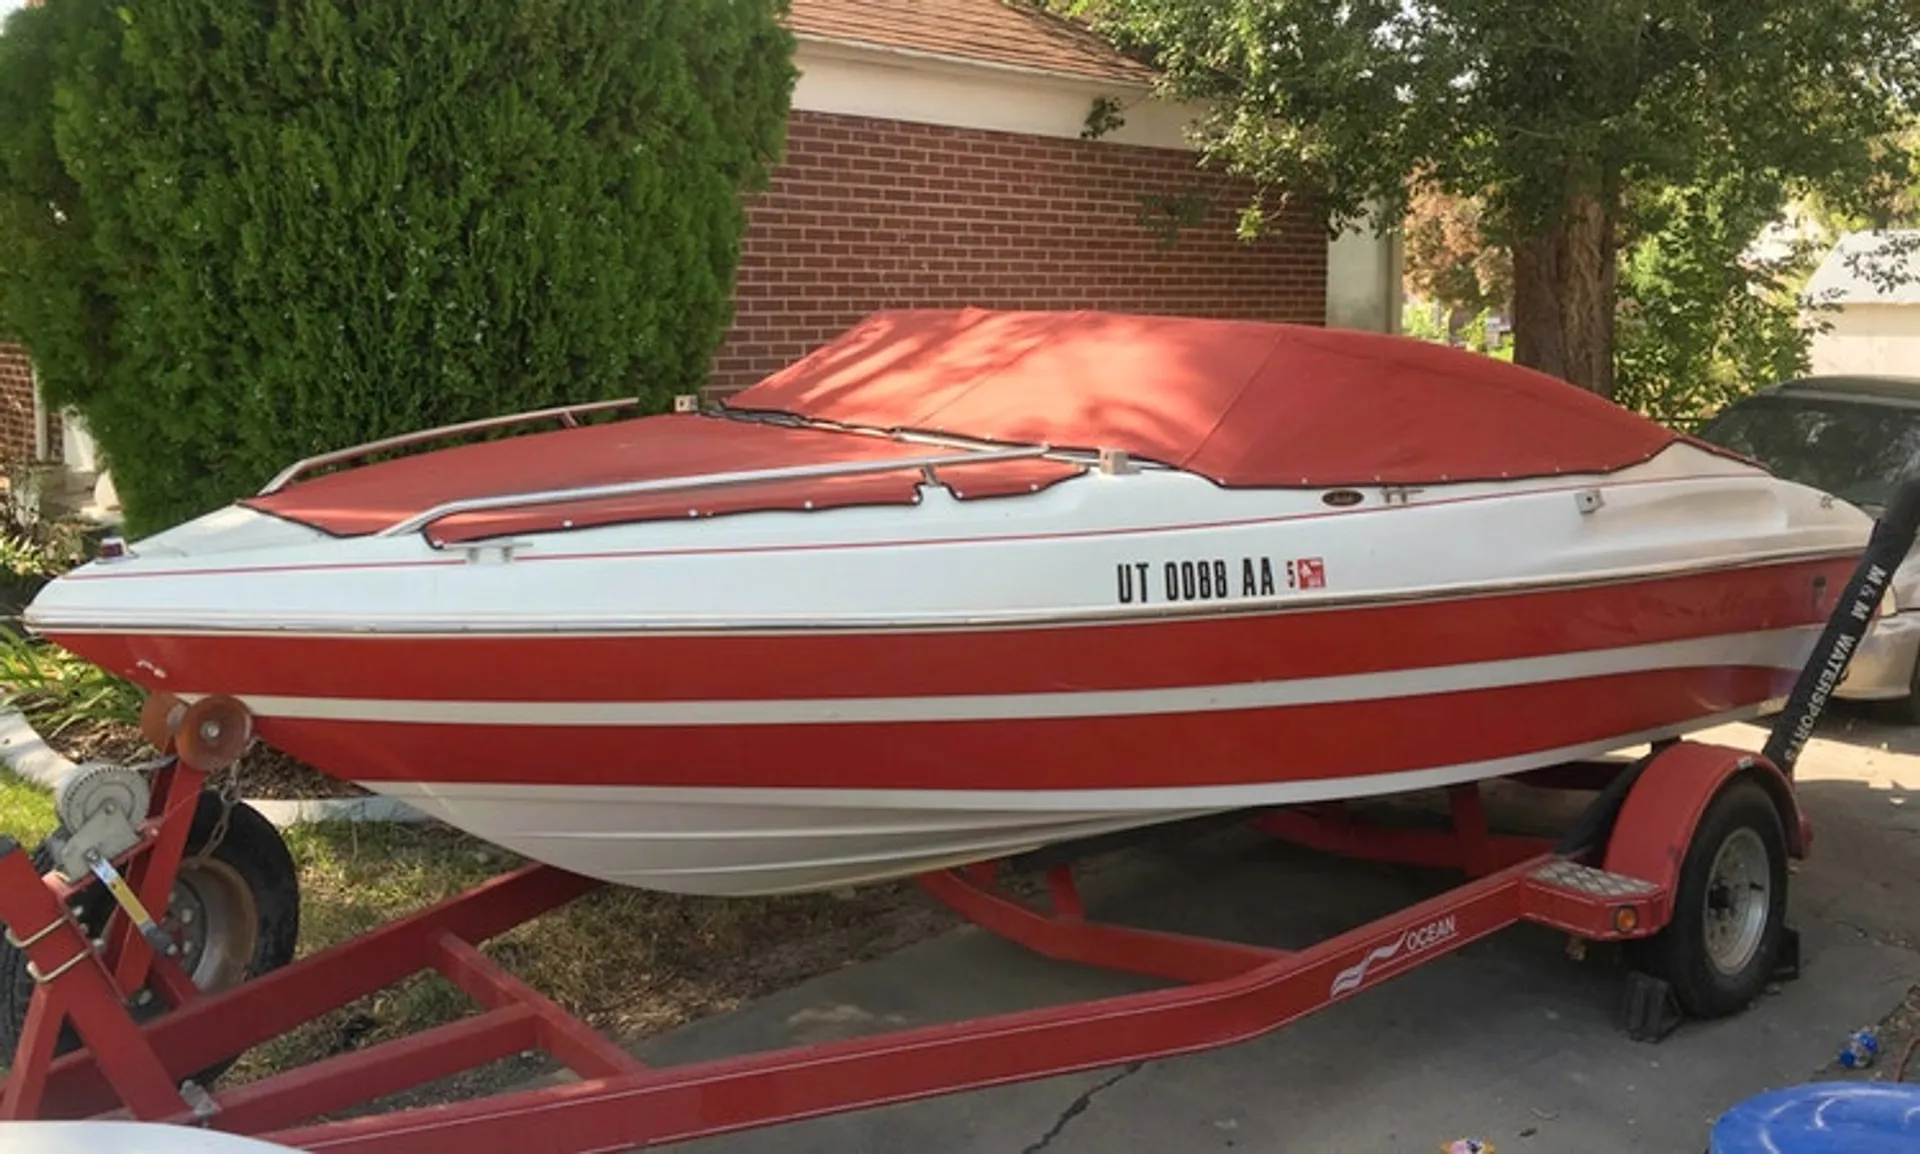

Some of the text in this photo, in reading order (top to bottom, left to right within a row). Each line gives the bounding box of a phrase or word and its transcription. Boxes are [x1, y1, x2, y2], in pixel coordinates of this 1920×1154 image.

[1117, 556, 1275, 604] UT 0088 AA
[1866, 563, 1887, 585] M
[1850, 600, 1870, 621] M
[1406, 915, 1456, 951] OCEAN
